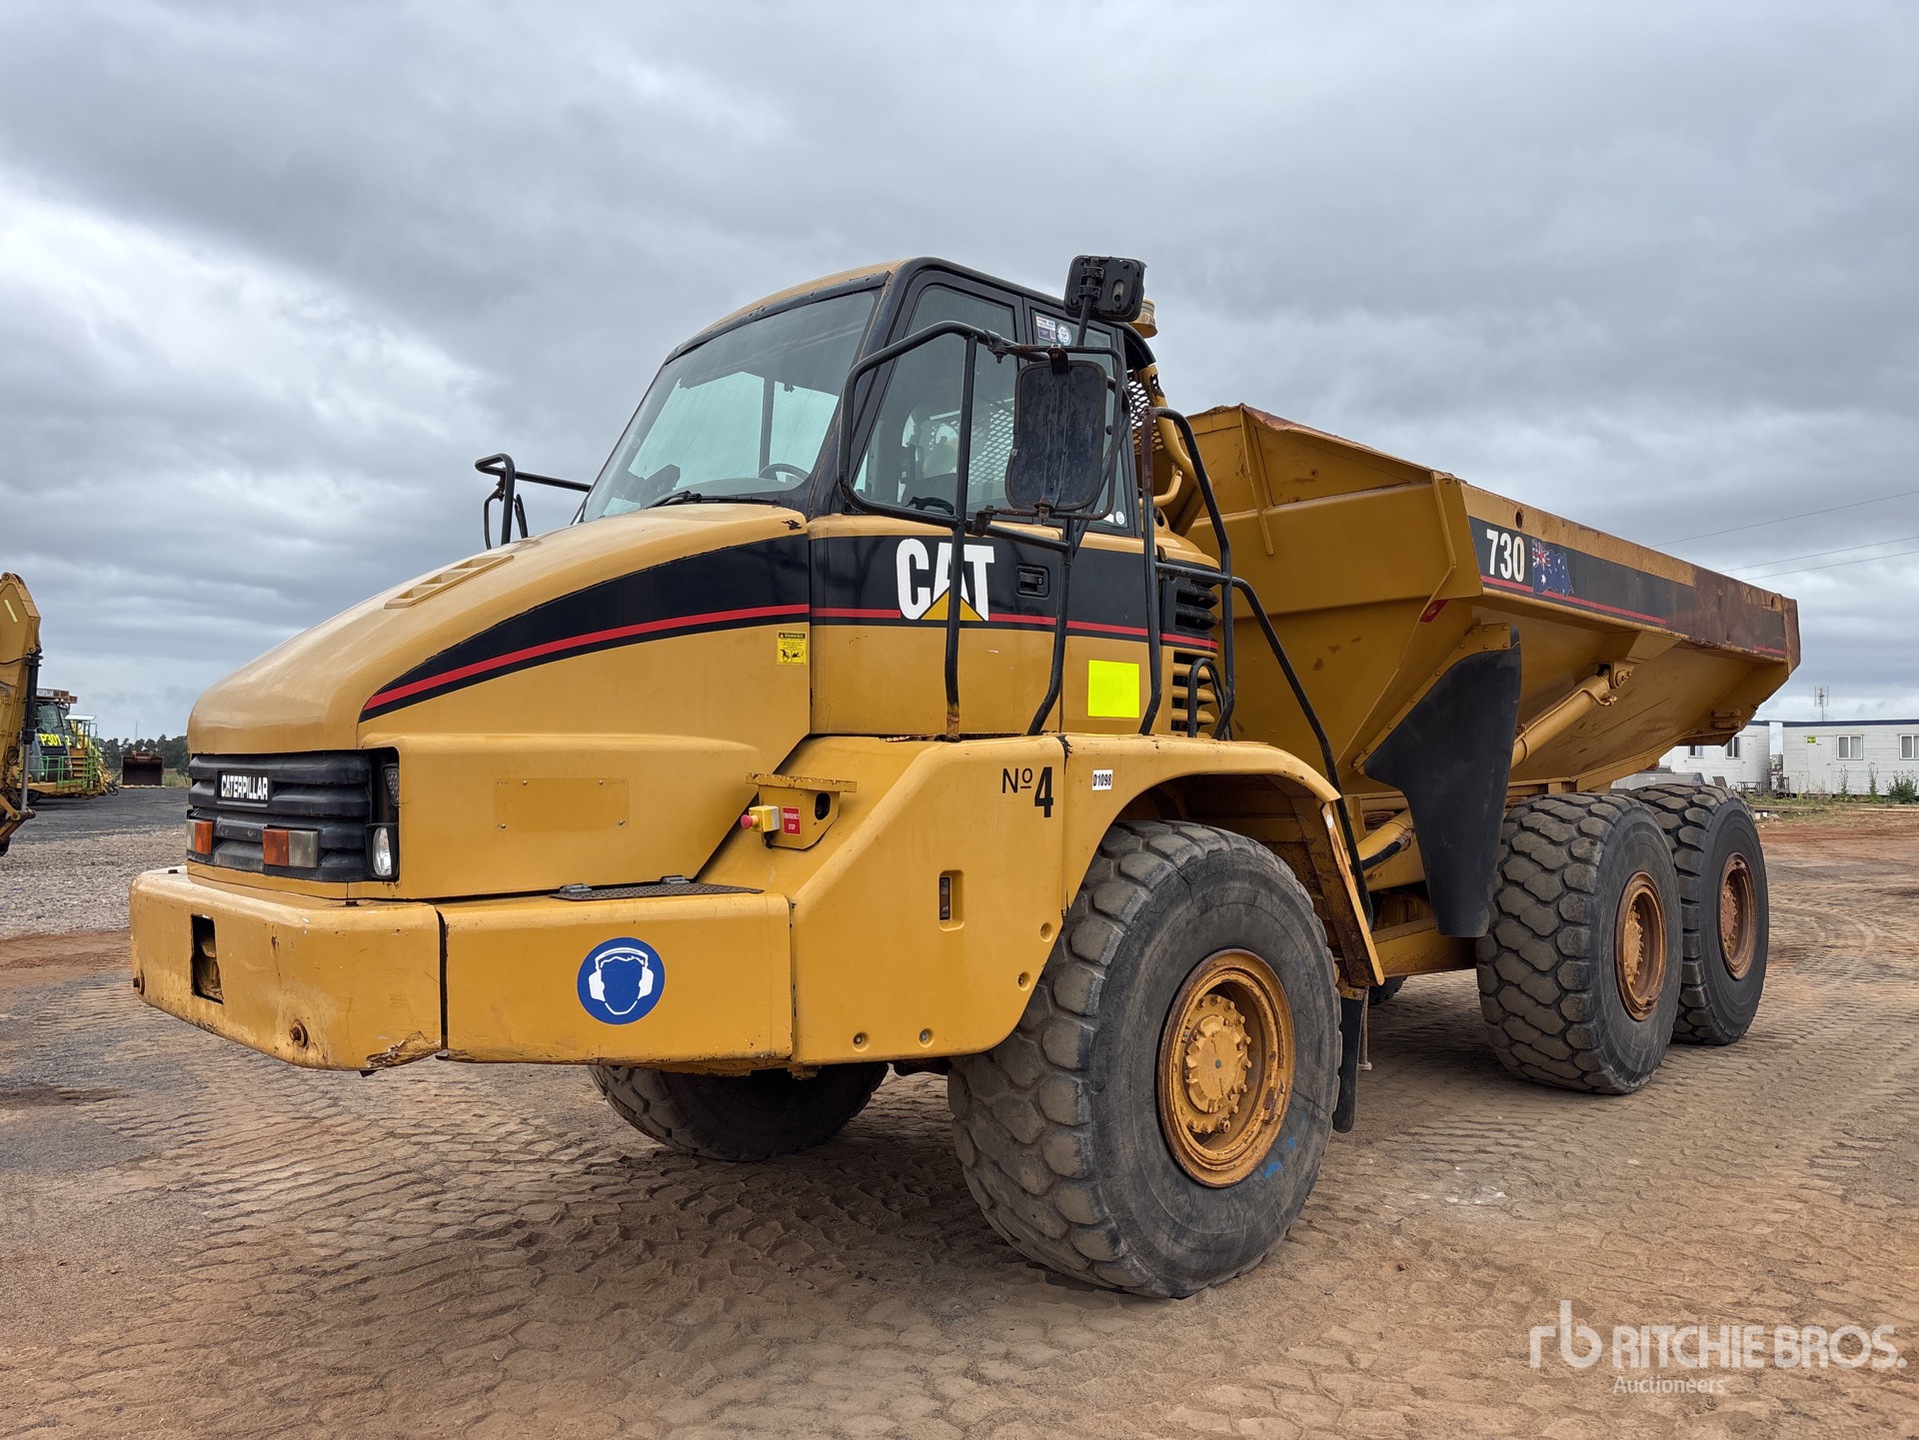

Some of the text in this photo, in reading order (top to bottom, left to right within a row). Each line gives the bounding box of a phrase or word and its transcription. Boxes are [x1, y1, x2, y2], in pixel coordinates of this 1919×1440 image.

[896, 538, 995, 621] CAT
[1486, 528, 1525, 583] 730
[221, 774, 268, 801] CATERPILLAR
[1034, 766, 1054, 818] 4
